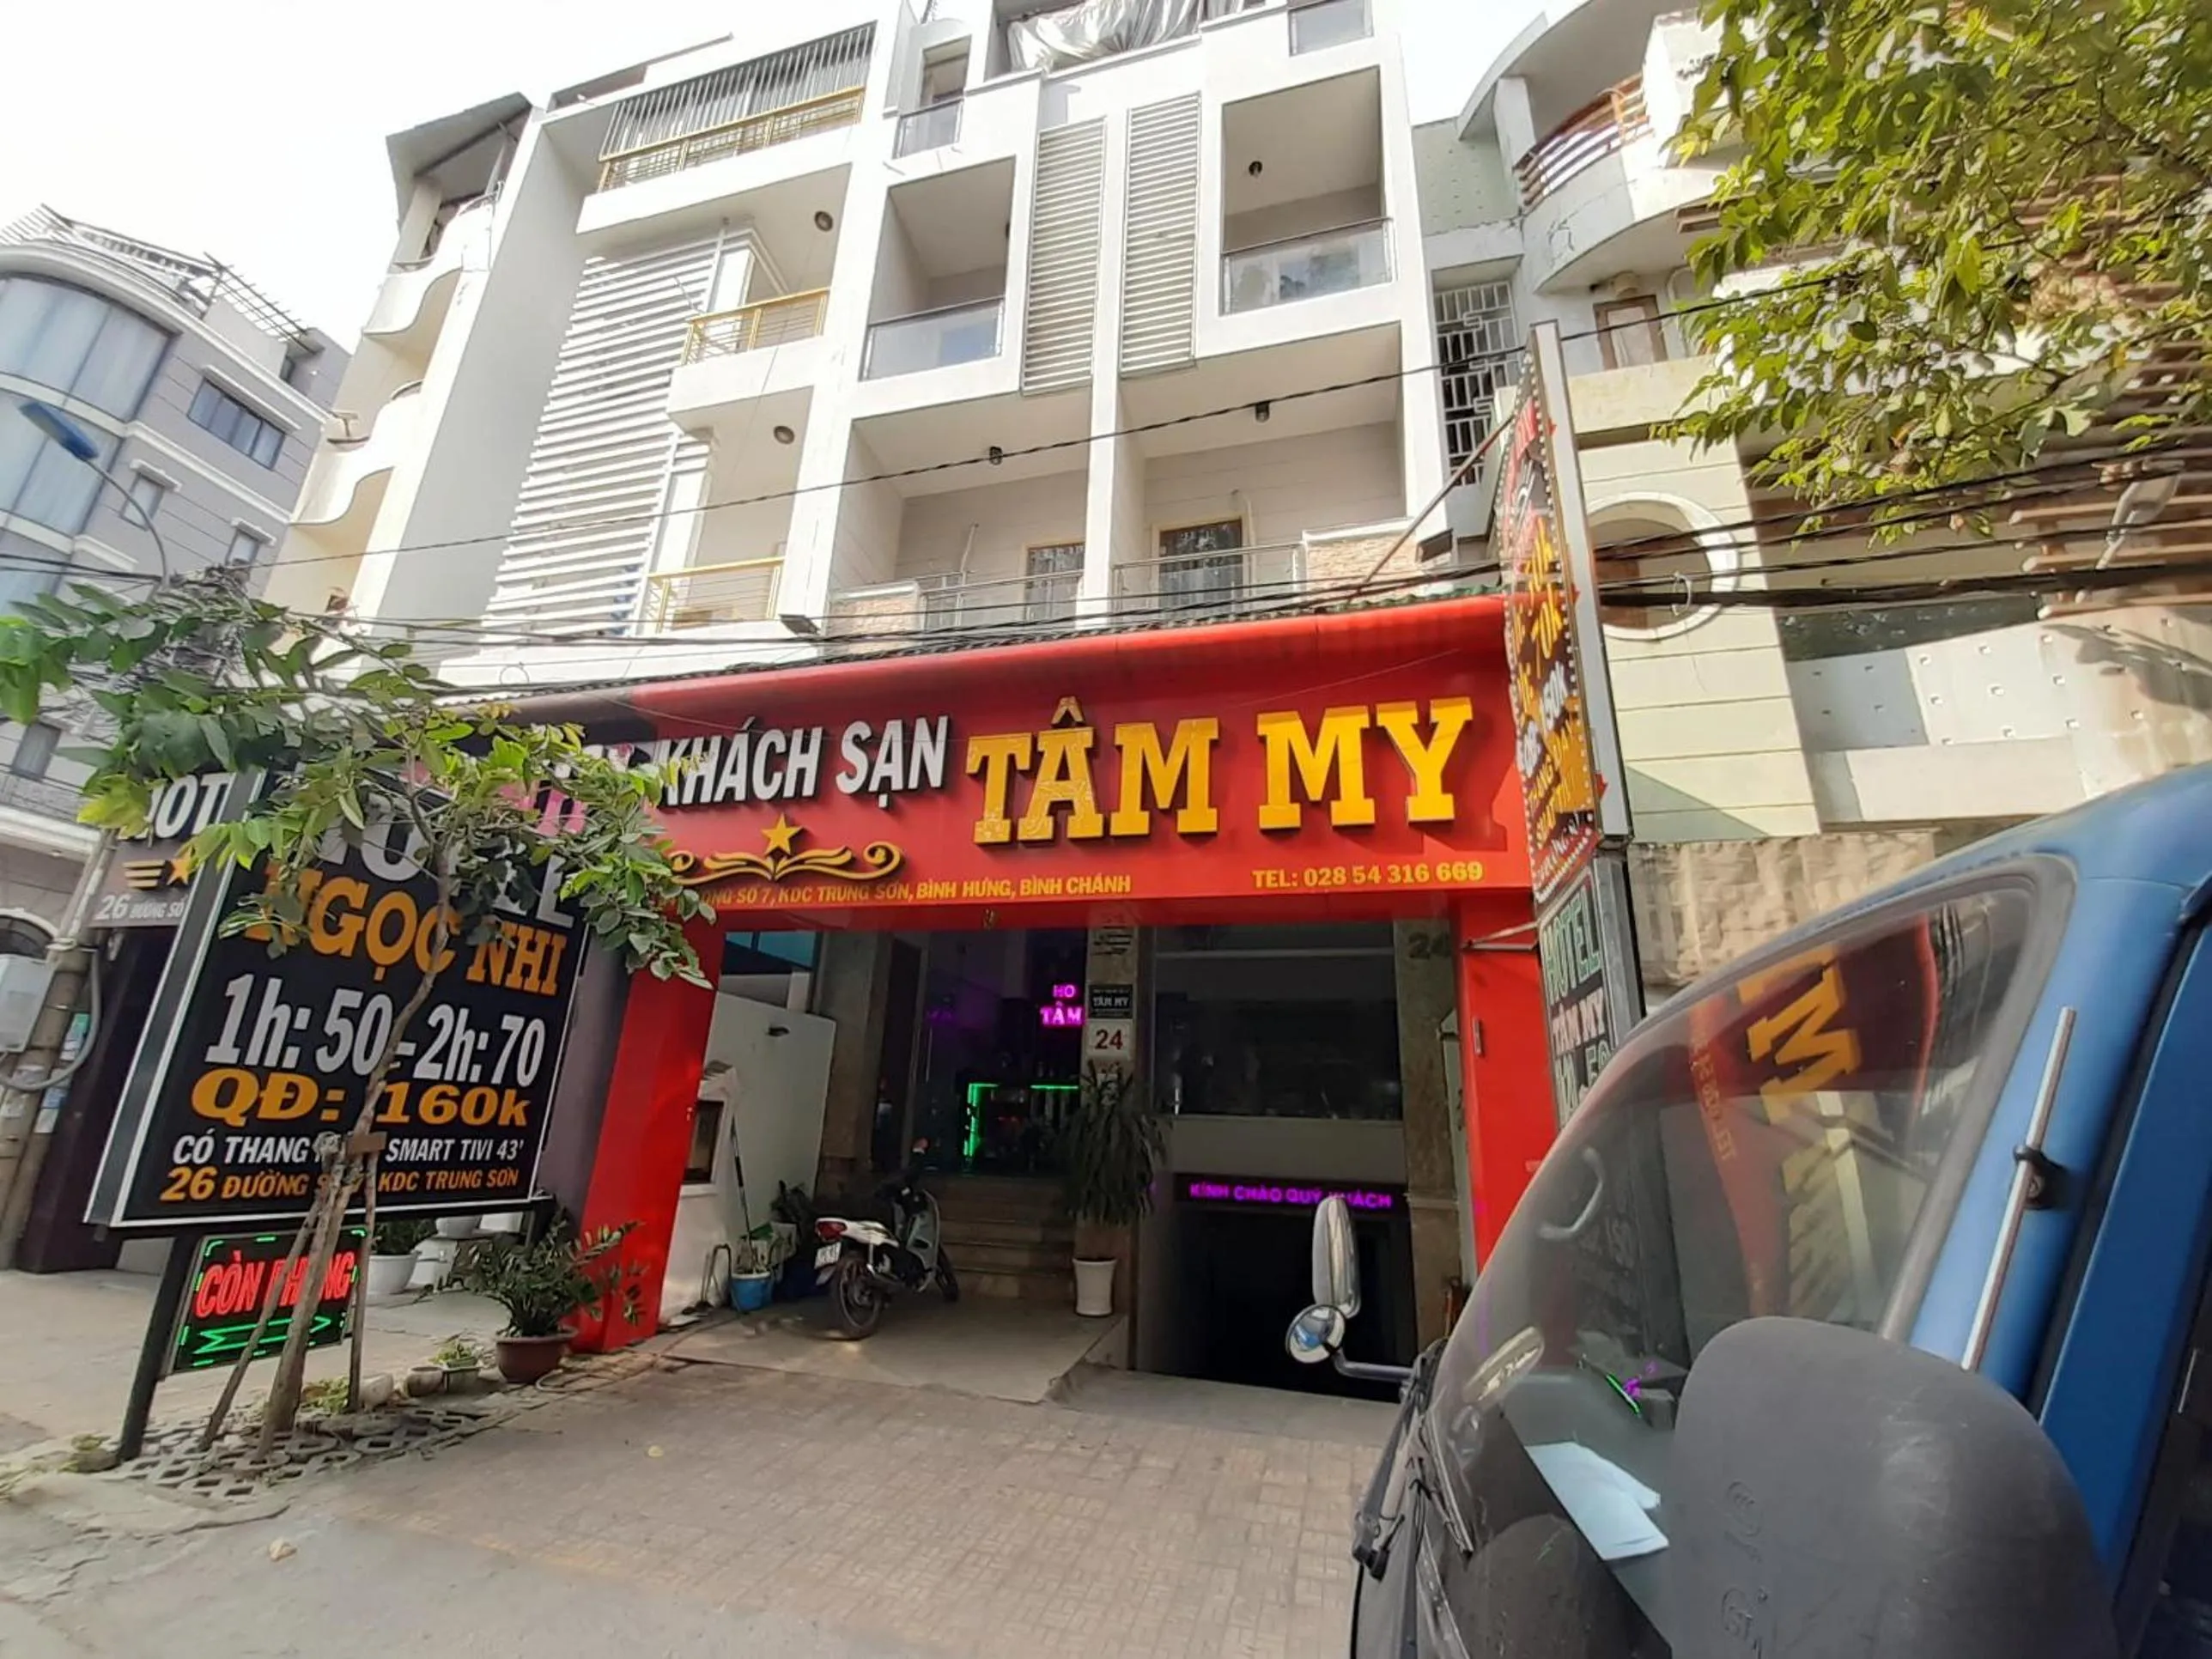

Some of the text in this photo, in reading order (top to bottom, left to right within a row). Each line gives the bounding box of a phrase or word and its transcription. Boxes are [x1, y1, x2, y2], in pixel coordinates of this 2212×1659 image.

[654, 715, 949, 808] KHÁCH SẠN
[966, 696, 1219, 845] TÂM
[1256, 696, 1474, 830] MY
[778, 885, 813, 902] KDC
[817, 884, 871, 902] TRUNG
[916, 878, 957, 899] BÌNH
[1019, 874, 1062, 896] BÌNH
[1066, 872, 1132, 894] CHÁNH
[1252, 860, 1483, 888] TEL: 028 54 316 669
[94, 893, 131, 921] 26
[466, 921, 568, 996] NHI
[1543, 885, 1602, 1006] HOTEL
[1095, 1029, 1123, 1050] 24
[173, 1127, 216, 1164] CÓ
[223, 1136, 312, 1164] THANG
[385, 1138, 456, 1163] SMART
[459, 1139, 494, 1161] TIVI
[160, 1165, 218, 1202] 26
[221, 1169, 311, 1200] ĐƯỜNG
[377, 1170, 420, 1193] KDC
[425, 1168, 483, 1191] TRUNG
[194, 1249, 265, 1319] CÒN
